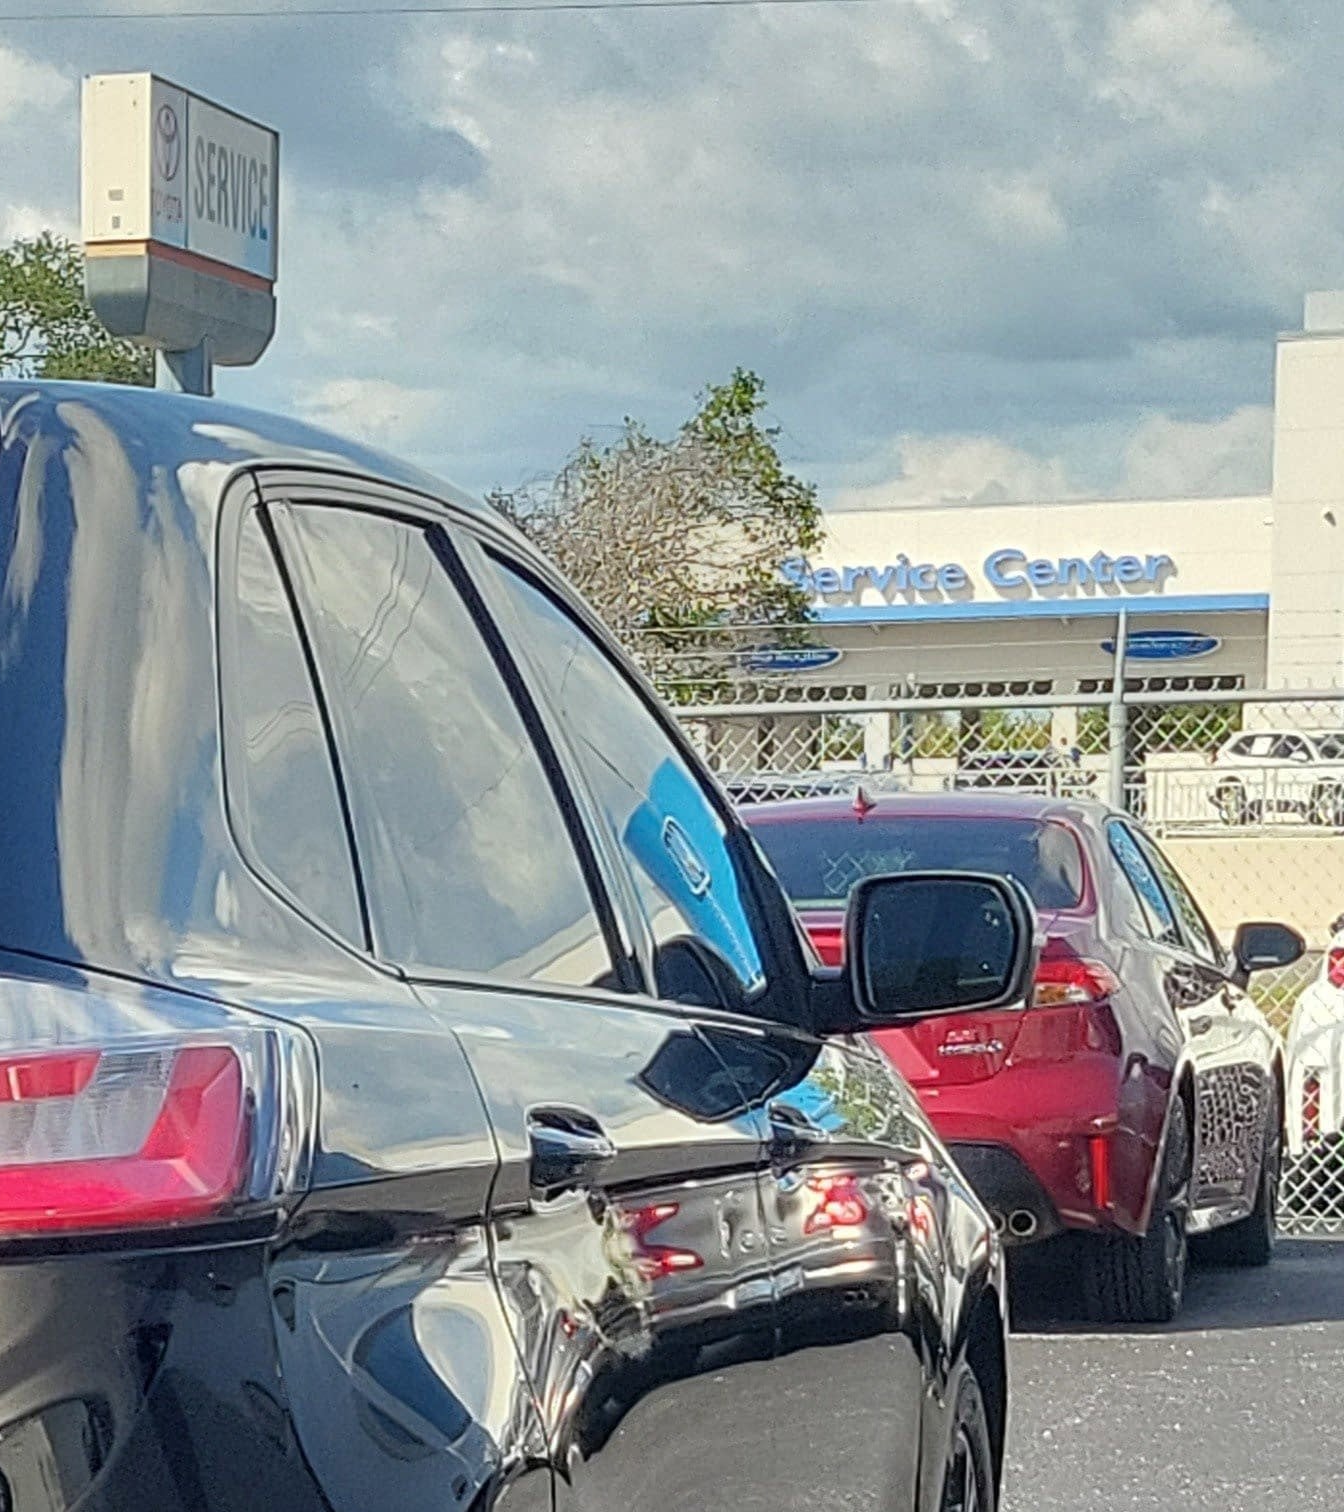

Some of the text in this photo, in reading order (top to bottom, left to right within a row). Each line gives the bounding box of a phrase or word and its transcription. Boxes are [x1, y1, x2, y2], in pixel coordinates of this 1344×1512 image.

[193, 135, 269, 240] SERVICE
[780, 548, 1177, 594] Service Center
